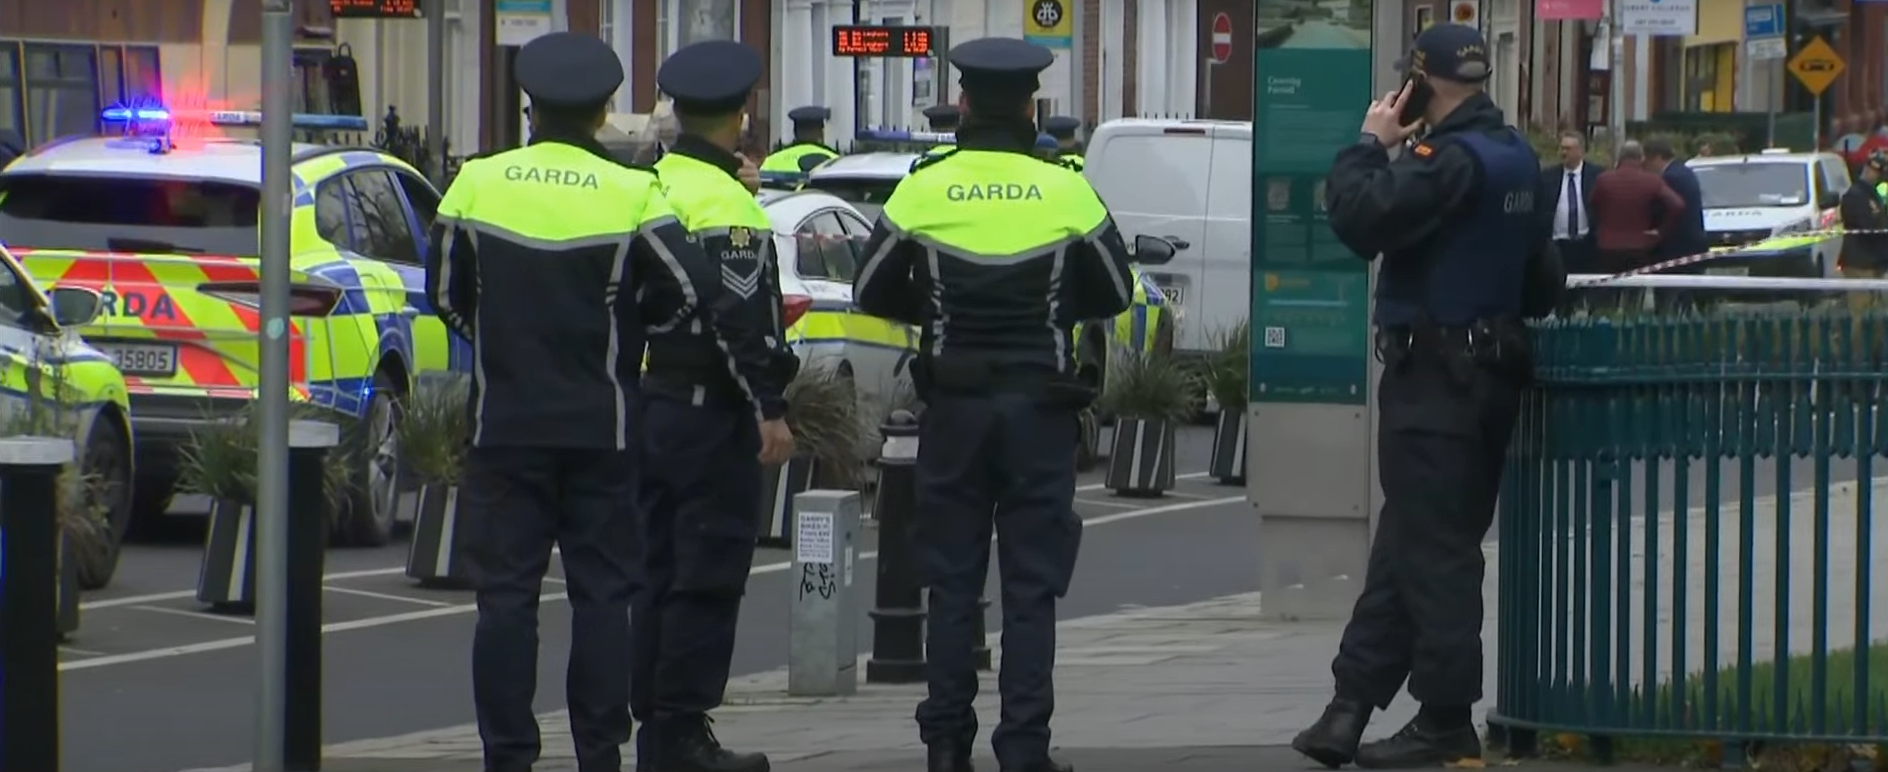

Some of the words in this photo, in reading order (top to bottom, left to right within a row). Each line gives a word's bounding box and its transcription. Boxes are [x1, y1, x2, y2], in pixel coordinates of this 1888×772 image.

[505, 165, 598, 190] GARDA
[947, 184, 1042, 201] GARDA
[99, 291, 175, 319] RDA
[1161, 289, 1179, 302] 92
